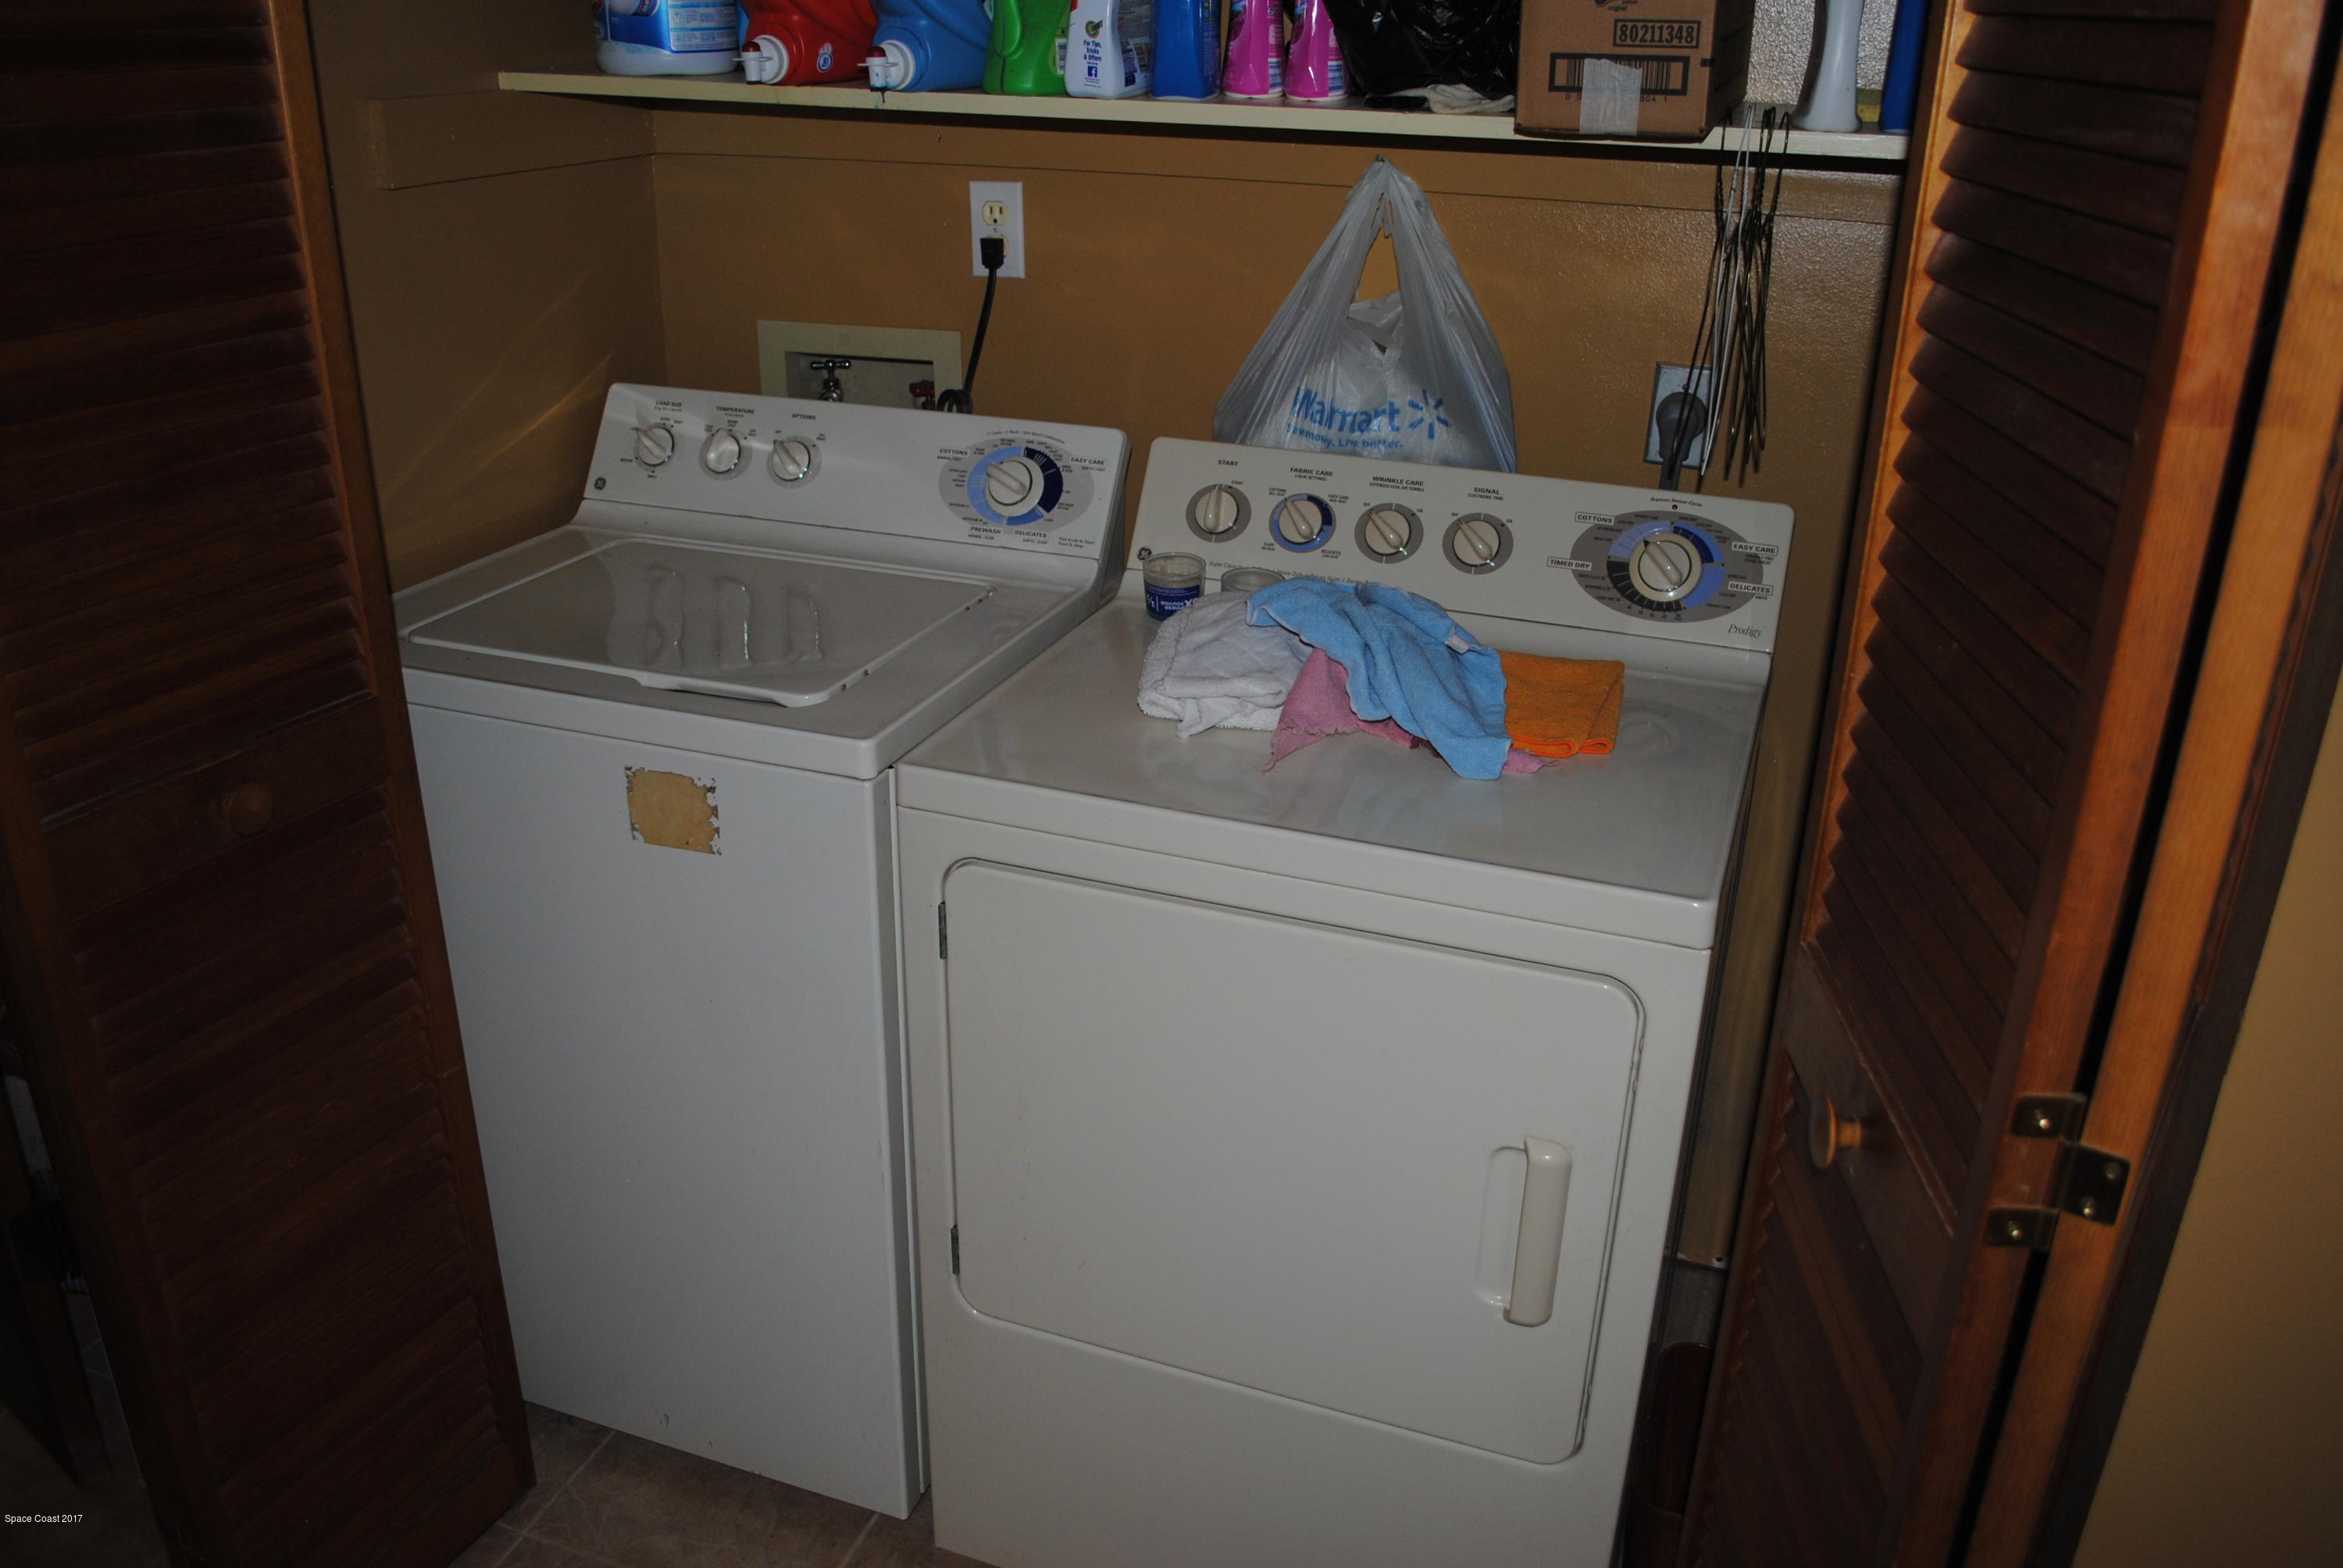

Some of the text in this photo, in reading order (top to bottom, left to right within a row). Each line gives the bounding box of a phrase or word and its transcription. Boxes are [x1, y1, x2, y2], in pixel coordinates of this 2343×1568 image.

[1619, 23, 1694, 44] 80211348
[1372, 476, 1404, 485] WRINKLE
[1578, 515, 1612, 523] COTTONS
[1015, 529, 1047, 538] DELICATES
[1755, 545, 1775, 554] CARE
[1730, 583, 1771, 593] DELICATES
[1728, 624, 1761, 639] Prodigy
